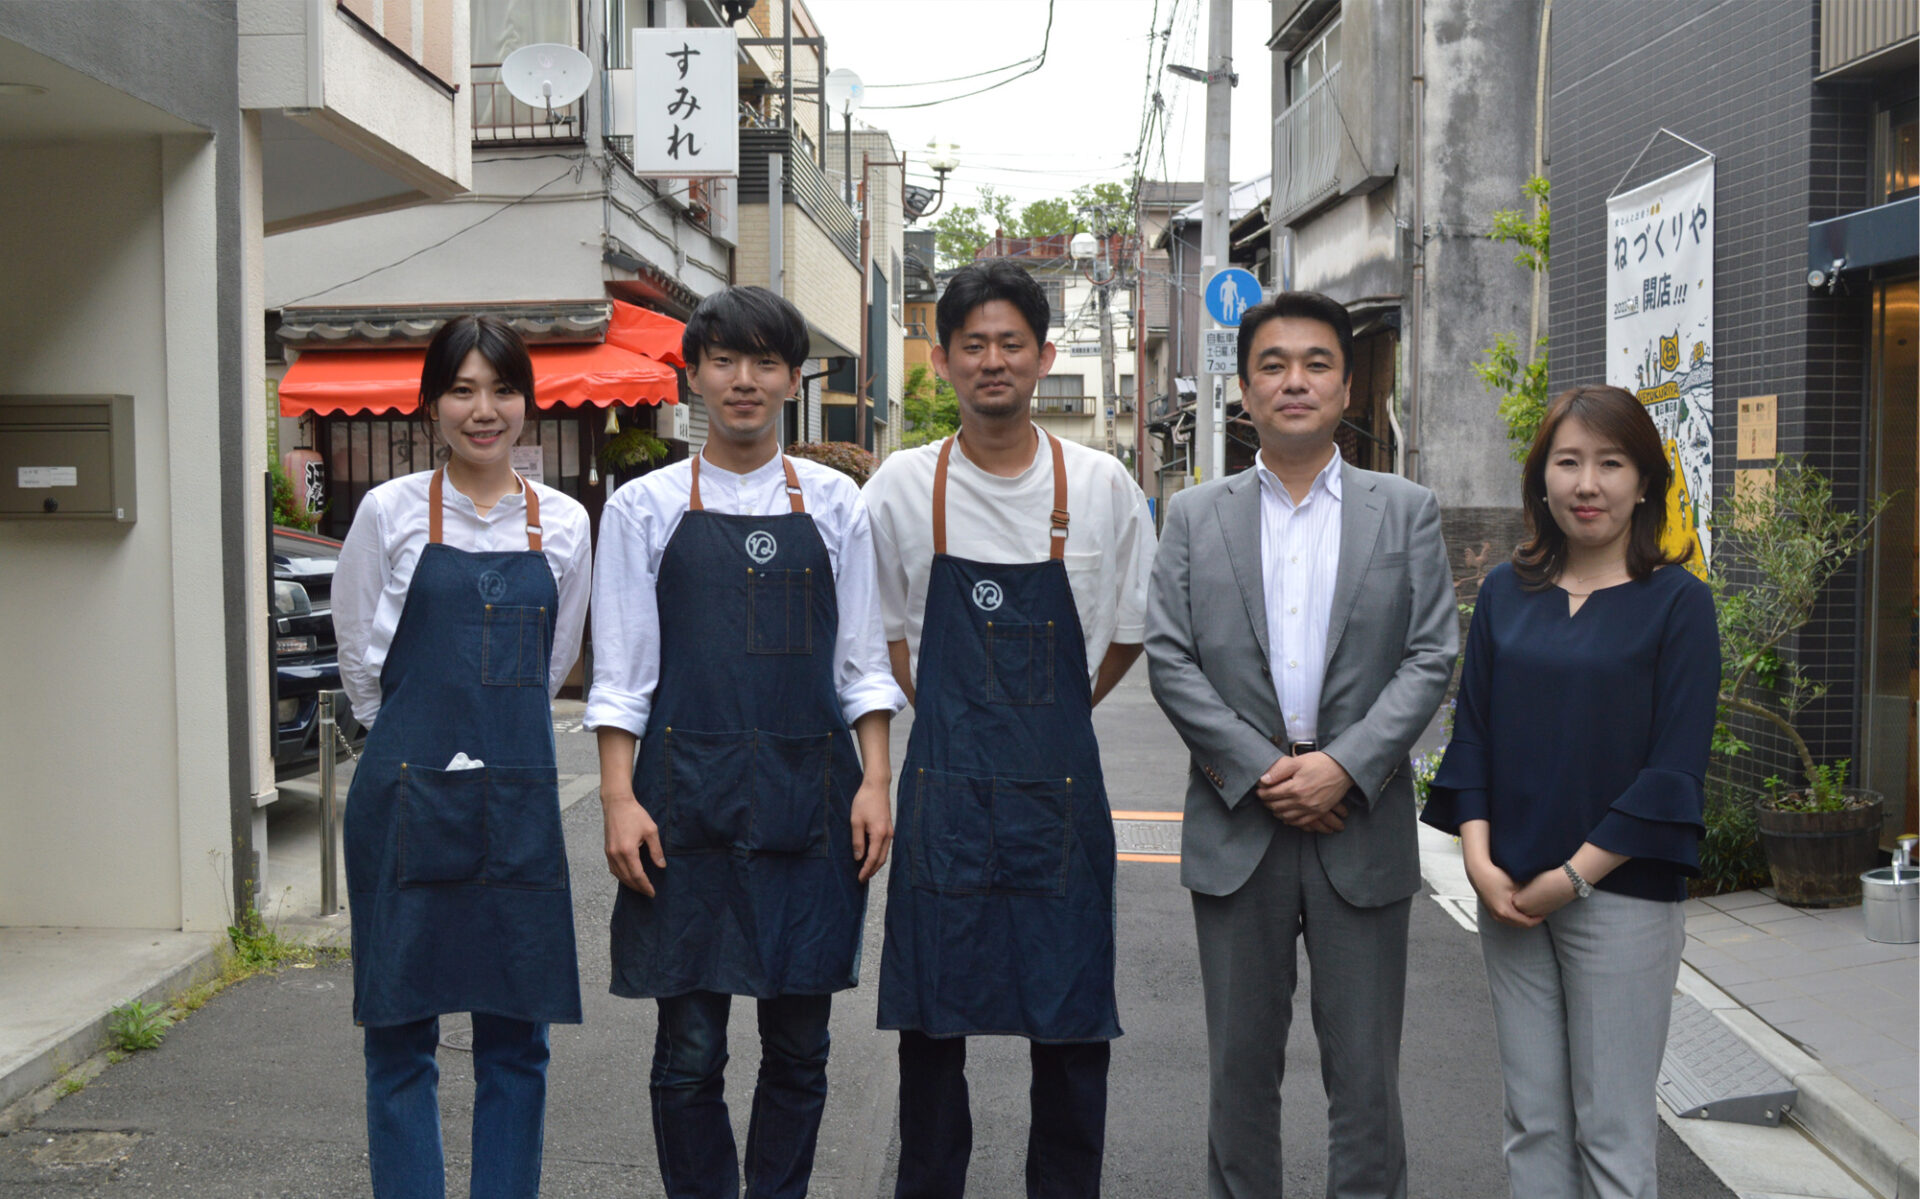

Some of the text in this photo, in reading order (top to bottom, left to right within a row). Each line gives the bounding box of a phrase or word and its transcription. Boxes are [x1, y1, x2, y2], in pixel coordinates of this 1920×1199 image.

[665, 42, 702, 160] すみれ
[1614, 202, 1707, 271] ねづくりや
[1643, 272, 1688, 312] 開店!!!
[1207, 332, 1238, 345] 自転車
